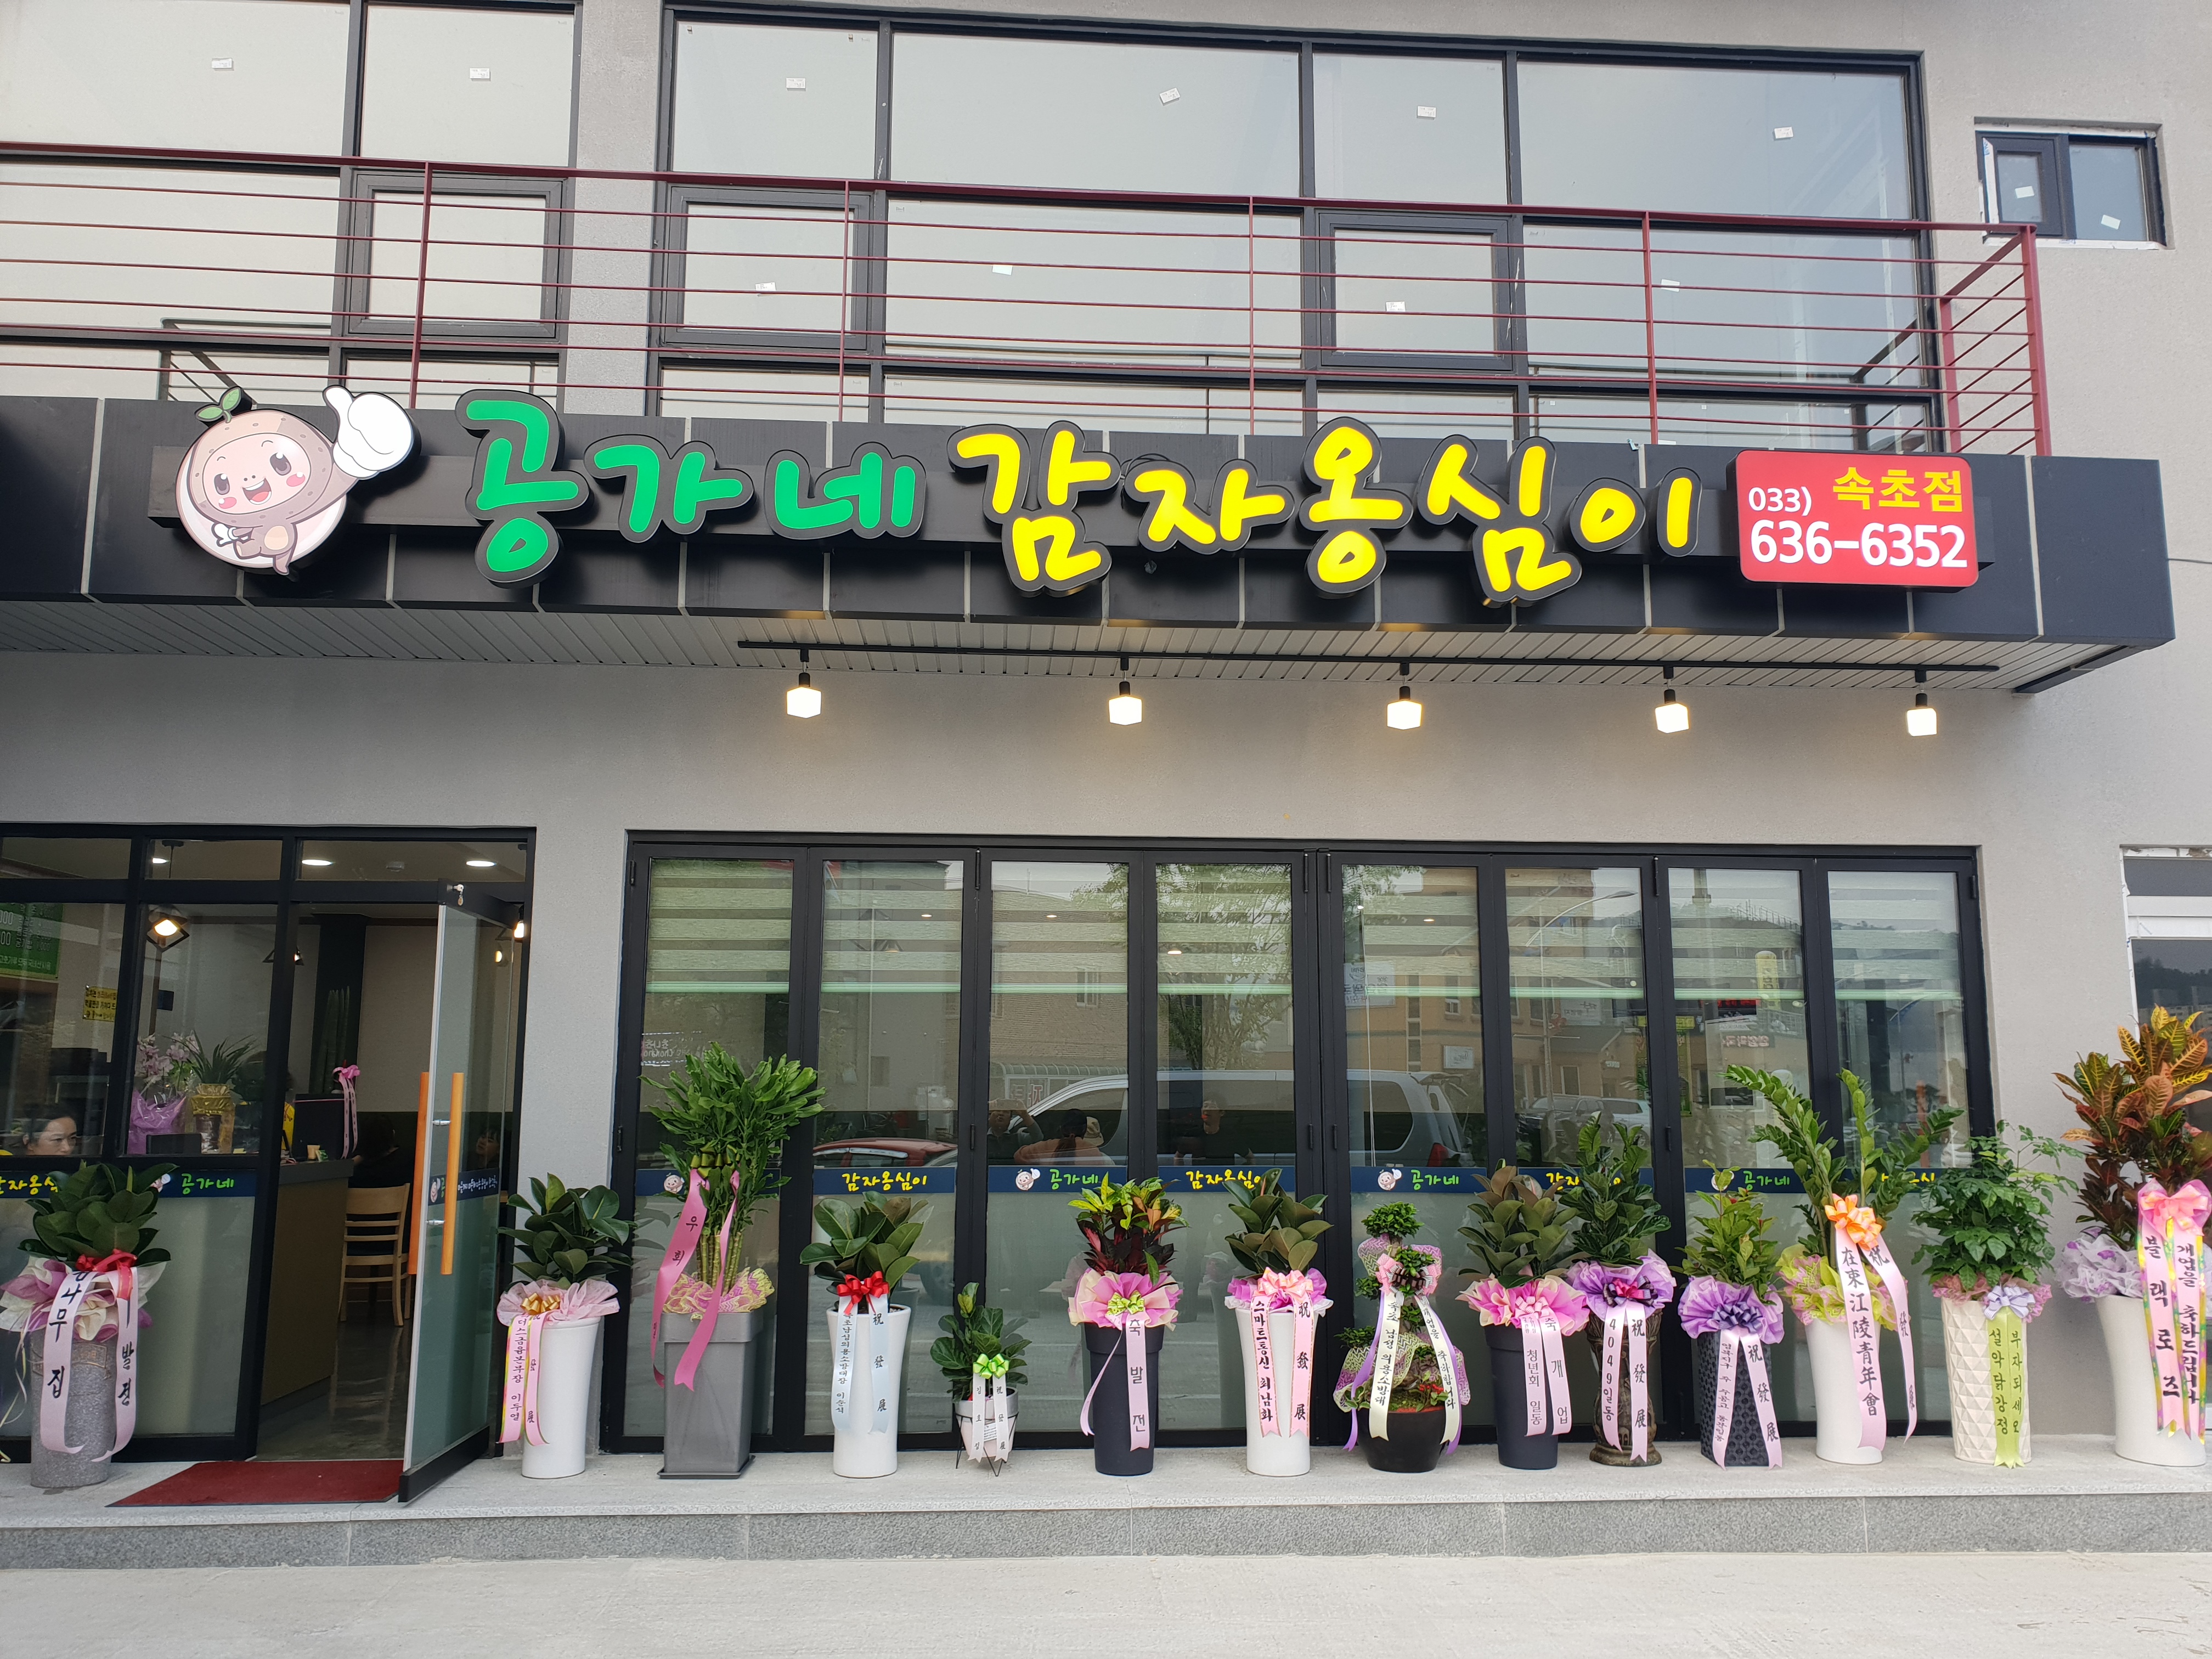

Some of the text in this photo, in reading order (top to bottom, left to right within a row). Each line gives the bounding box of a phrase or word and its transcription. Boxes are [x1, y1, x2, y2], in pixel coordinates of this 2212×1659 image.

[460, 398, 1694, 592] 공가네 감자옹심이
[1748, 486, 1812, 516] 033)
[1832, 466, 1963, 513] 속초점
[1750, 519, 1968, 568] 636-6352
[180, 1172, 235, 1195] 공가네
[842, 1172, 927, 1192] 감자옹심이
[1049, 1169, 1098, 1190] 공가네
[1410, 1169, 1459, 1190] 공가네
[1743, 1170, 1791, 1190] 공가네
[1253, 1300, 1271, 1370] 스마트통신
[1383, 1328, 1398, 1350] 남성
[2177, 1243, 2200, 1406] 개업을 축하드립니다
[511, 1315, 529, 1384] 더스금융본부장
[1527, 1349, 1540, 1387] 청년회
[1374, 1353, 1393, 1406] 의용소방대
[1989, 1328, 2009, 1436] 설악닭강정
[1530, 1400, 1542, 1425] 일동
